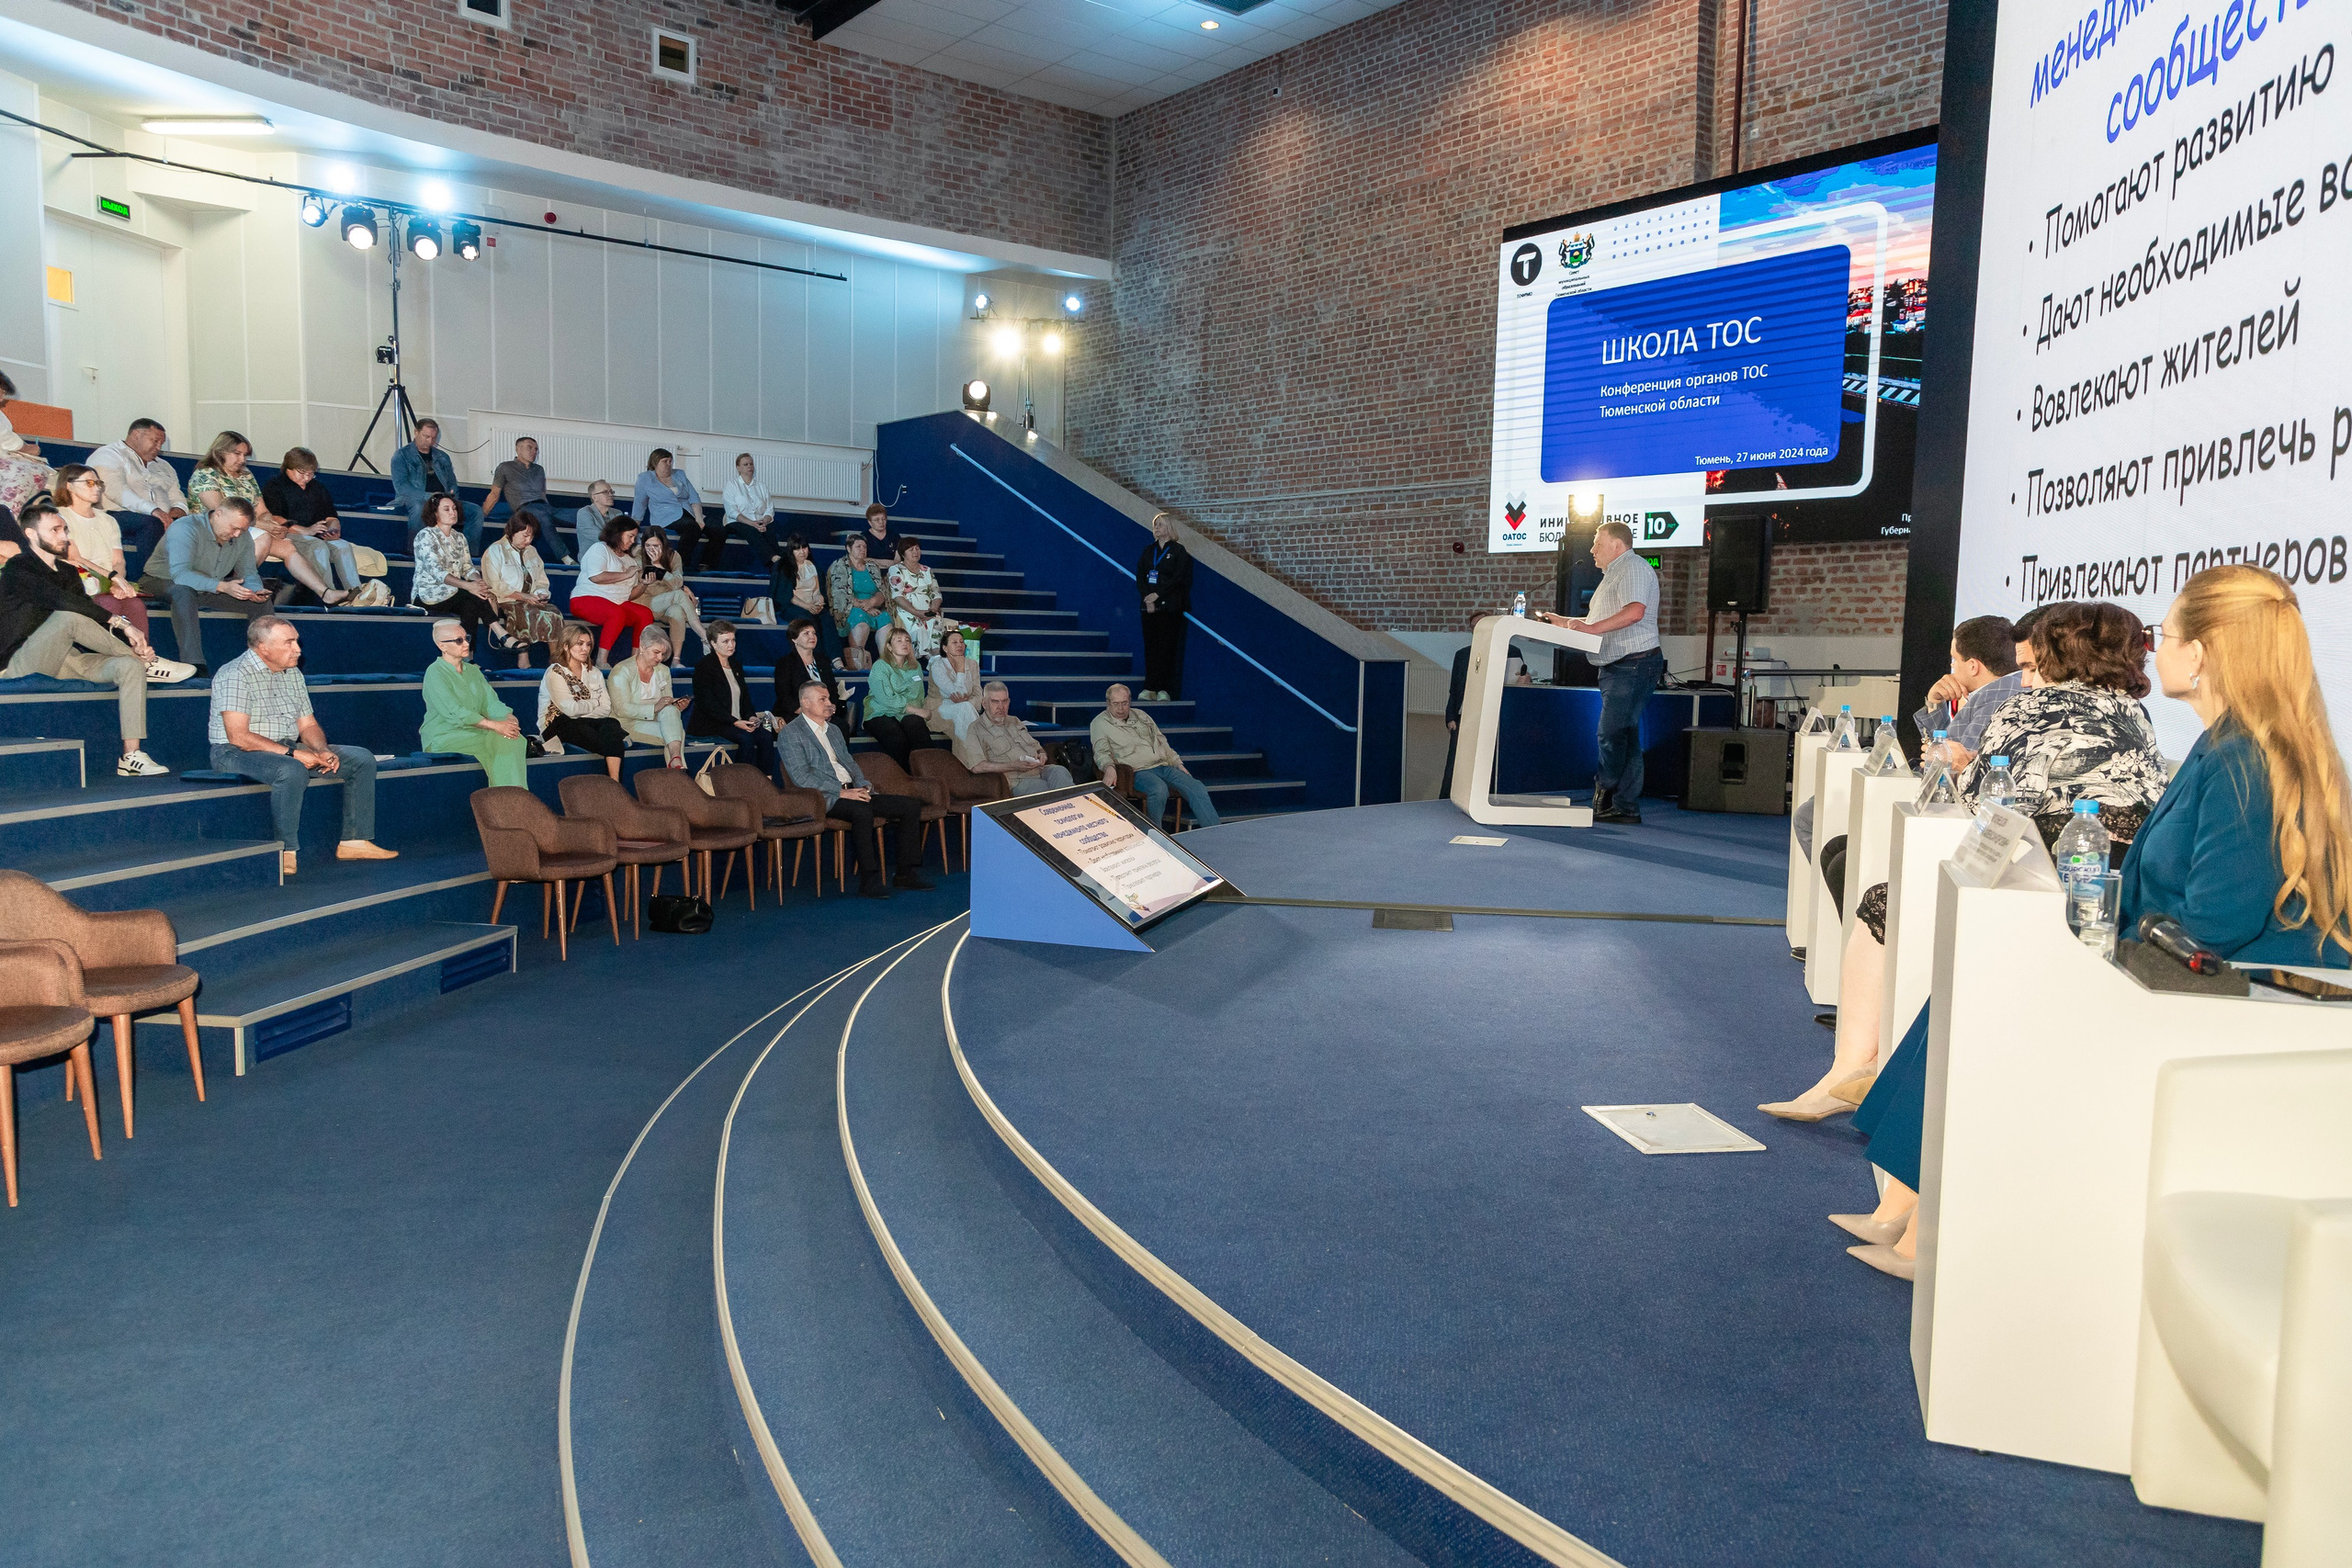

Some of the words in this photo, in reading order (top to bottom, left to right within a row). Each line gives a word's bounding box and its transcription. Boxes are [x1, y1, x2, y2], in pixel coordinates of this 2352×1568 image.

[2106, 0, 2310, 143] сообщес
[2045, 150, 2165, 259] Помогают
[2172, 43, 2334, 200] развитию
[102, 199, 129, 216] ВЫХОД
[2036, 287, 2094, 355] Дают
[2099, 178, 2304, 316] необходимые
[1601, 326, 1698, 365] ШКОЛА
[1706, 316, 1762, 349] ТОС
[2031, 355, 2154, 432] Вовлекают
[2160, 276, 2301, 389] жителей
[1600, 378, 1681, 400] Конференция
[1686, 371, 1738, 390] органов
[1742, 364, 1769, 379] ТОС
[1600, 399, 1666, 418] Тюменской
[1669, 395, 1720, 410] области
[1695, 456, 1734, 466] Тюмень,
[1736, 452, 1748, 463] 27
[1749, 450, 1776, 461] июня
[1779, 447, 1804, 459] 2024
[1805, 446, 1828, 457] года
[2027, 456, 2154, 517] Позволяют
[2163, 418, 2315, 506] привлечь
[1502, 533, 1527, 541] ОАТОС
[1647, 517, 1667, 535] 10
[2021, 555, 2163, 606] Привлекают
